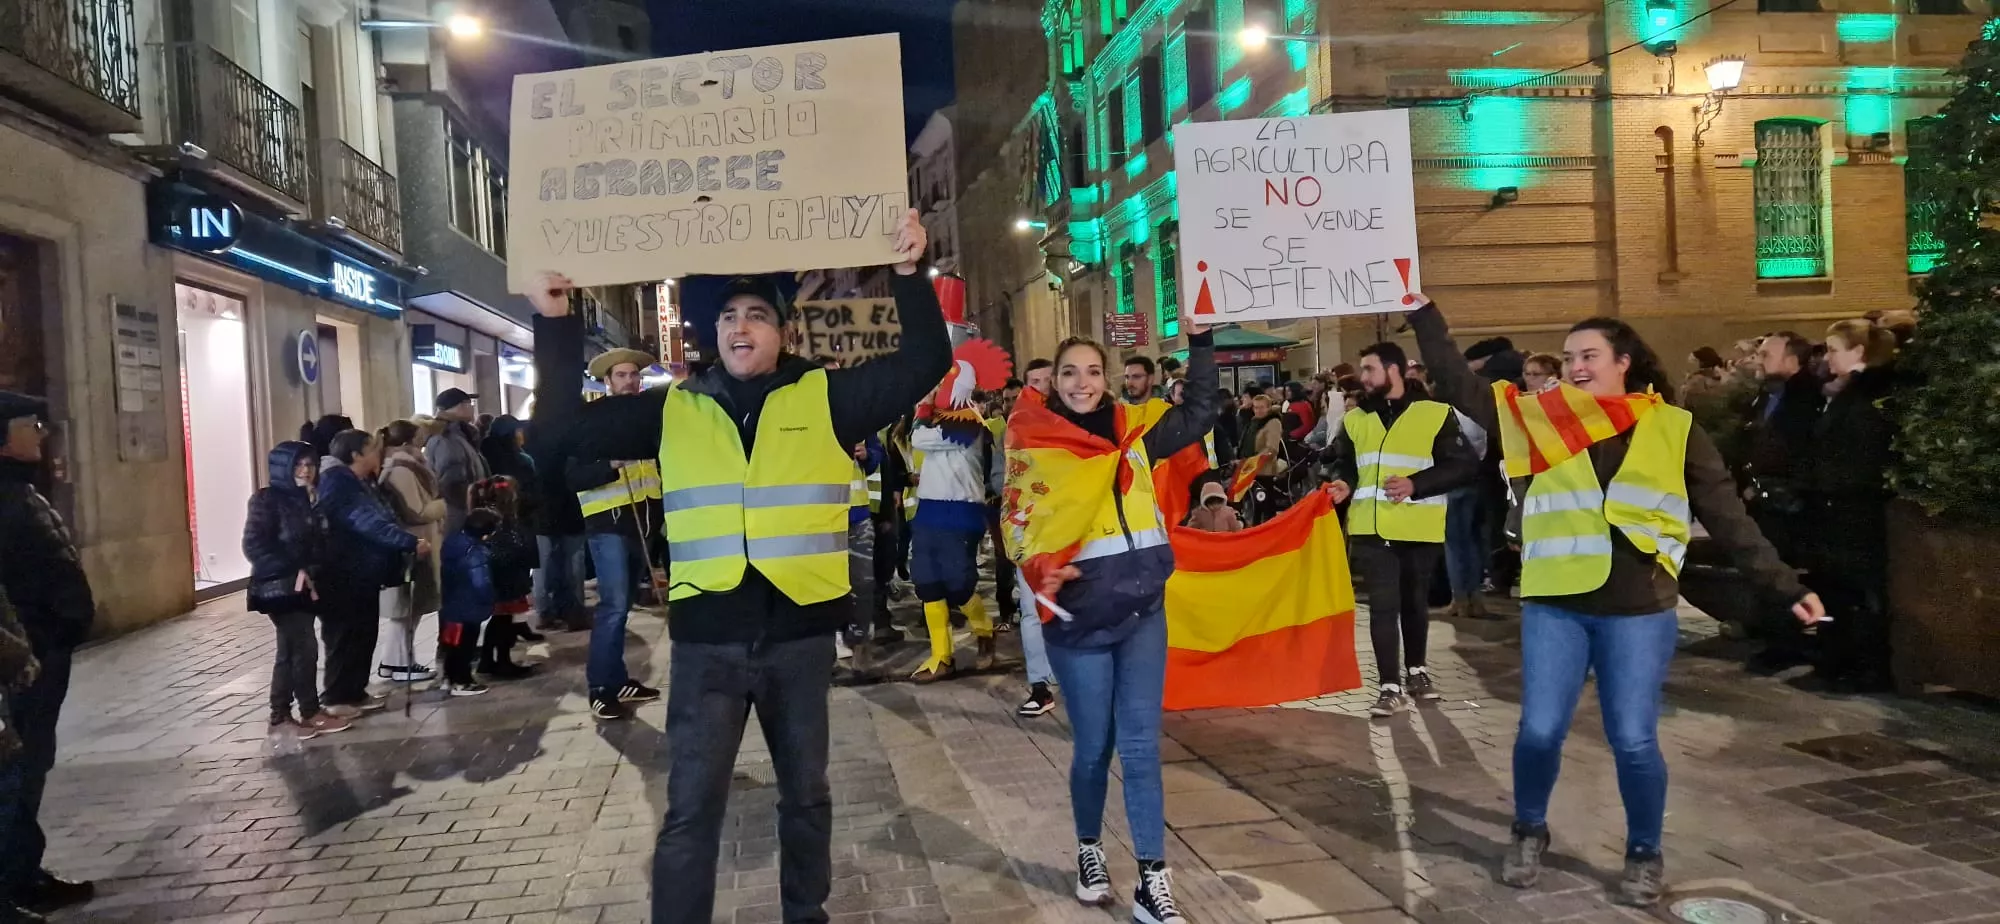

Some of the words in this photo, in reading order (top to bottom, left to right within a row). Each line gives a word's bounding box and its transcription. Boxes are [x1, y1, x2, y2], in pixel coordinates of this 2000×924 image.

[530, 78, 585, 119] EL
[607, 52, 827, 112] SECTOR
[1256, 120, 1297, 141] LA
[1194, 140, 1389, 174] AGRICULTURA
[540, 149, 786, 201] AGRADECE
[1265, 176, 1322, 207] NO
[190, 207, 231, 238] IN
[541, 204, 752, 255] VUESTRO
[768, 192, 906, 242] APOYO
[1214, 207, 1251, 229] SE
[1304, 207, 1385, 231] VENDE
[1262, 235, 1307, 266] SE
[333, 261, 376, 305] INSIDE
[658, 285, 670, 363] FARMACIA
[801, 304, 855, 330] POR
[870, 304, 898, 325] EL
